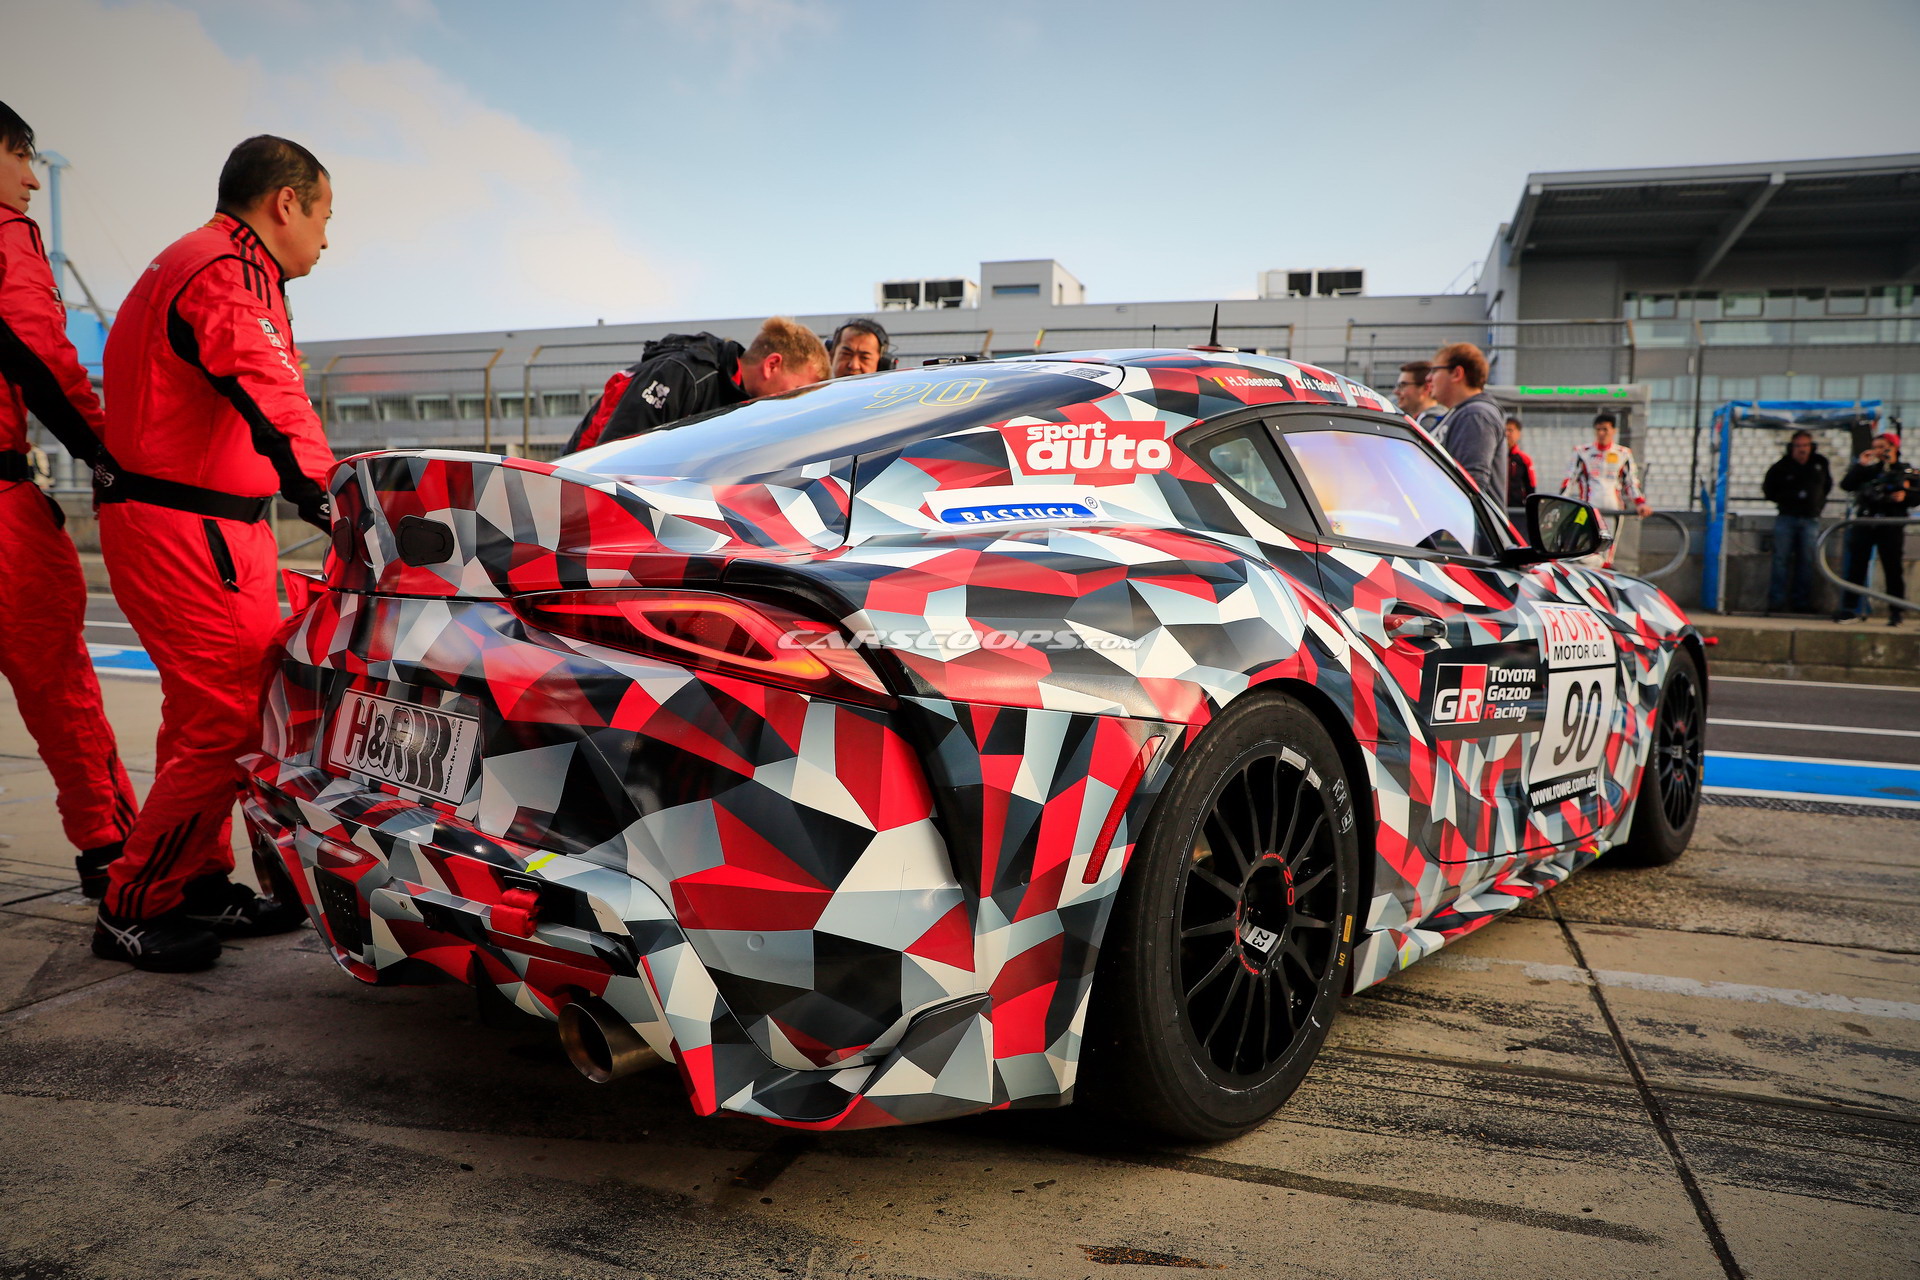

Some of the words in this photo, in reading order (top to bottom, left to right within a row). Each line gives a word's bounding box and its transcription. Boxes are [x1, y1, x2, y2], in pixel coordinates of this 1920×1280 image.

[864, 377, 989, 409] 90
[1026, 421, 1107, 443] sport
[1026, 434, 1172, 470] auto
[959, 505, 1084, 524] BASTUCK
[1543, 608, 1605, 642] ROWE
[1553, 645, 1590, 661] MOTOR
[1592, 643, 1607, 658] OIL
[1489, 666, 1537, 683] TOYOTA
[1486, 685, 1532, 701] GAZOO
[1434, 688, 1483, 721] GR
[1483, 702, 1528, 723] Racing
[1553, 680, 1603, 766] 90
[1530, 769, 1597, 806] www.rowe.com.de
[1251, 929, 1270, 948] 23
